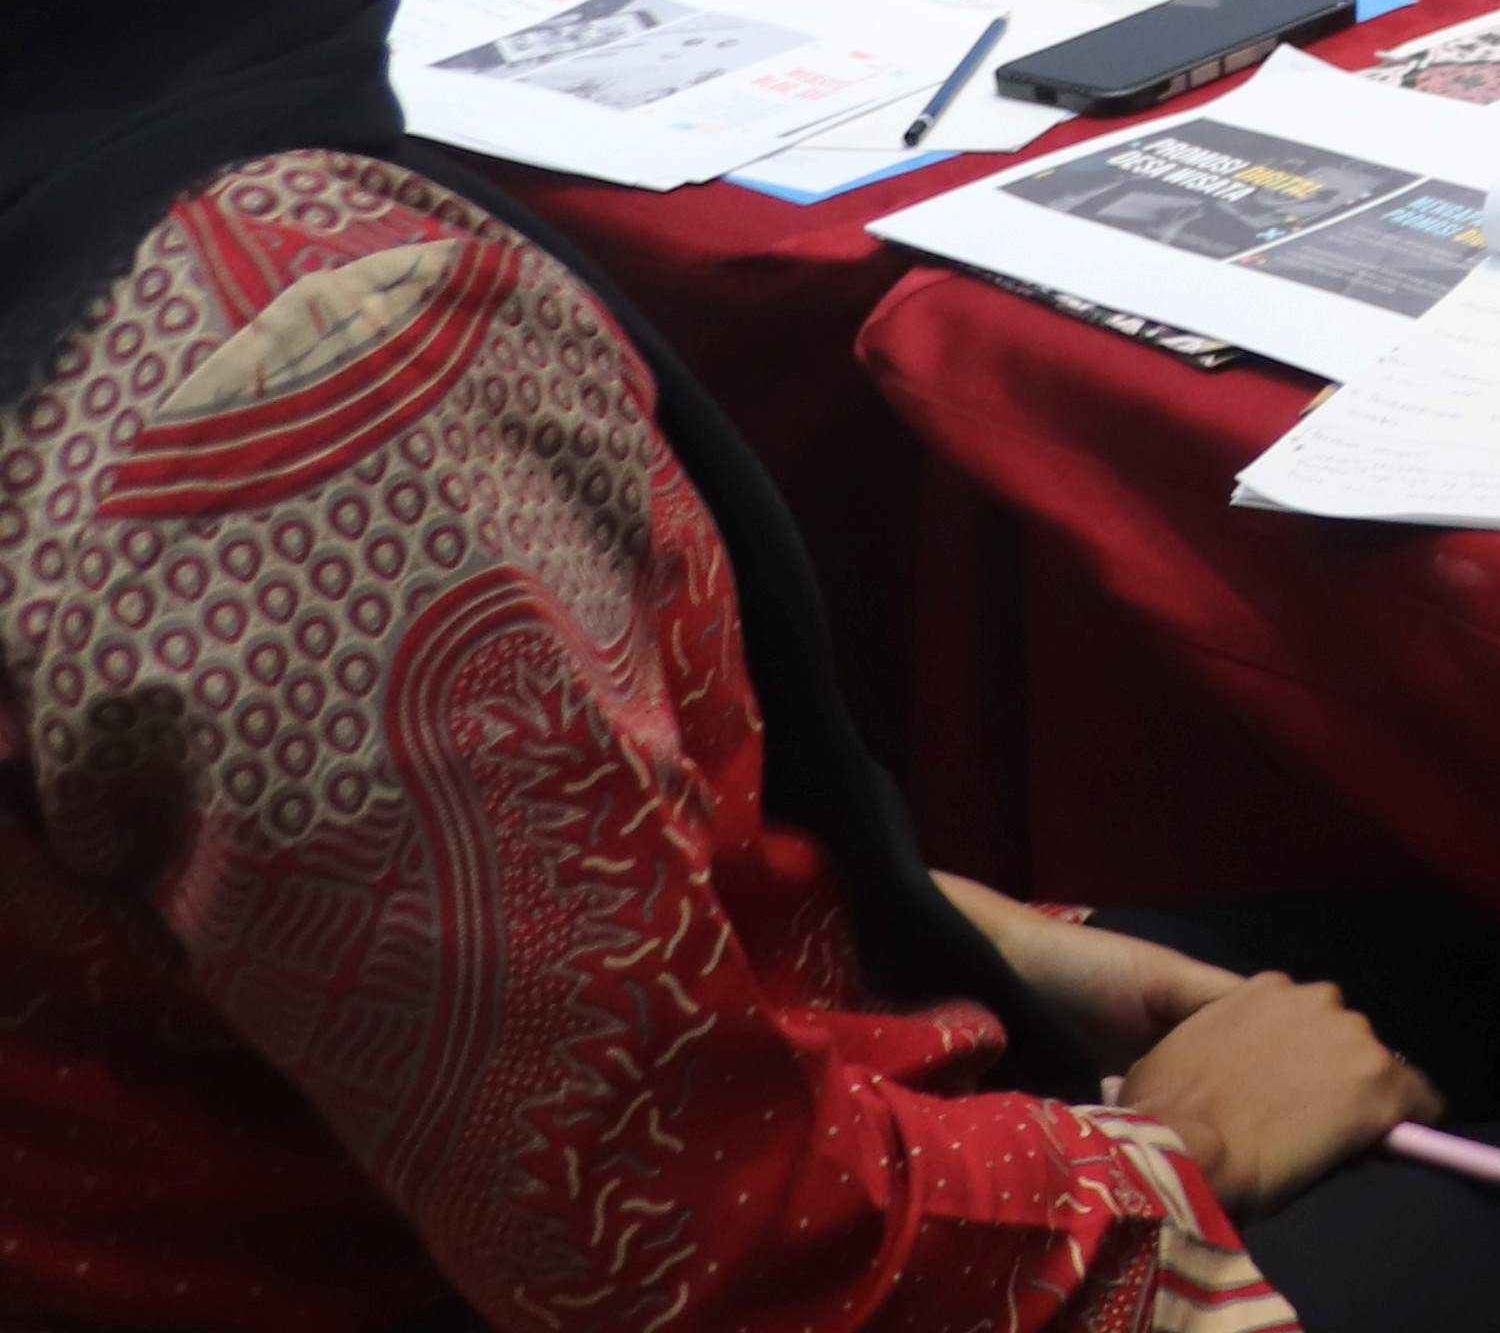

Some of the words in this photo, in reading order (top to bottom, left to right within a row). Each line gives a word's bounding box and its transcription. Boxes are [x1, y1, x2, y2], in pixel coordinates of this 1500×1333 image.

[1105, 149, 1178, 180] DESA
[1161, 166, 1257, 204] WISATA
[1142, 137, 1252, 176] PROMOSI
[1231, 164, 1327, 199] DIGITAL
